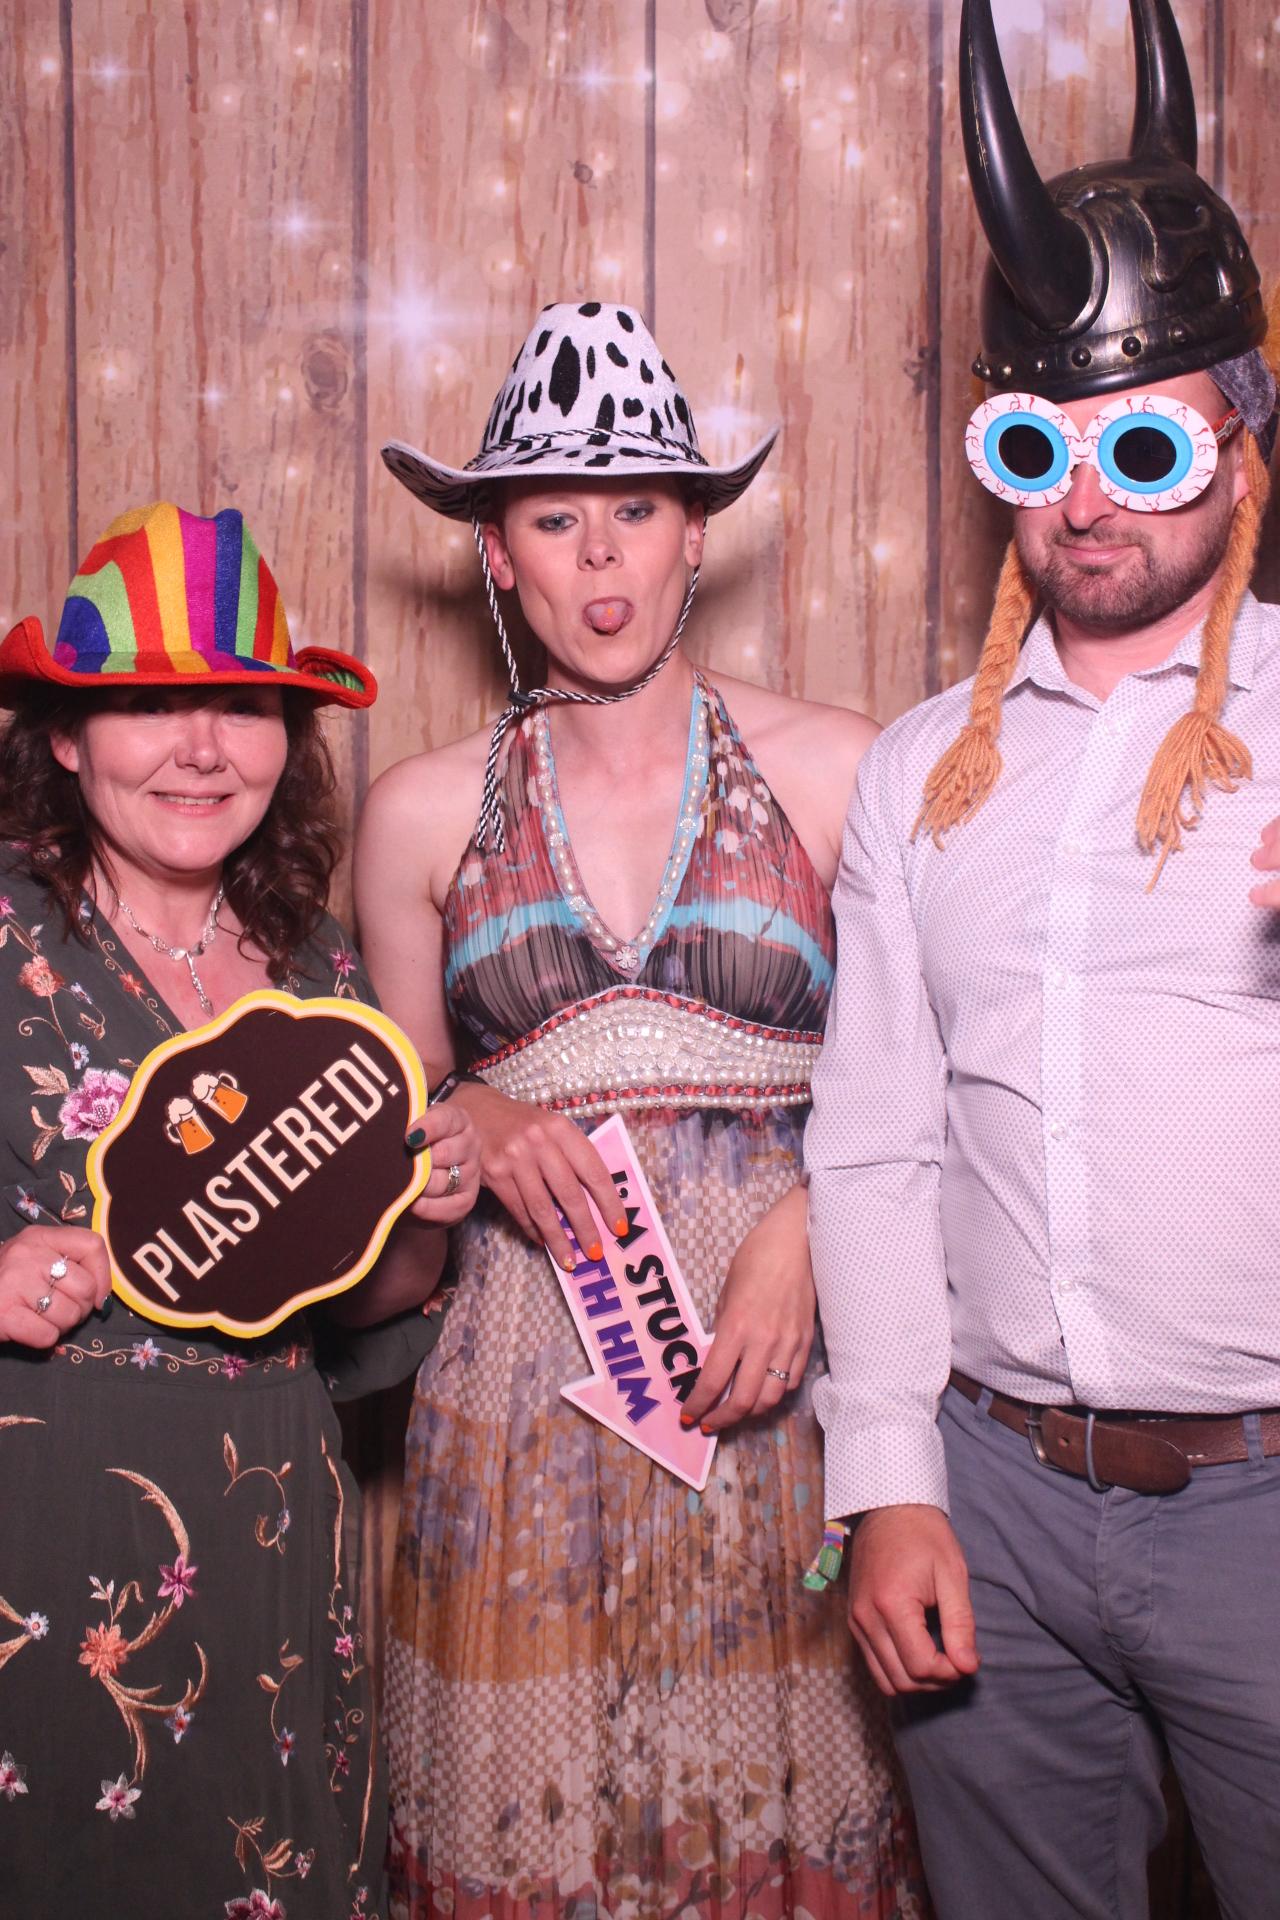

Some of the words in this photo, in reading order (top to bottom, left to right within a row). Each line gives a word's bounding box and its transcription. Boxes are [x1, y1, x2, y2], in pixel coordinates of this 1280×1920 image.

[132, 1043, 401, 1302] PLASTERED!
[596, 1320, 661, 1424] HIM
[624, 1254, 702, 1404] STUCK
